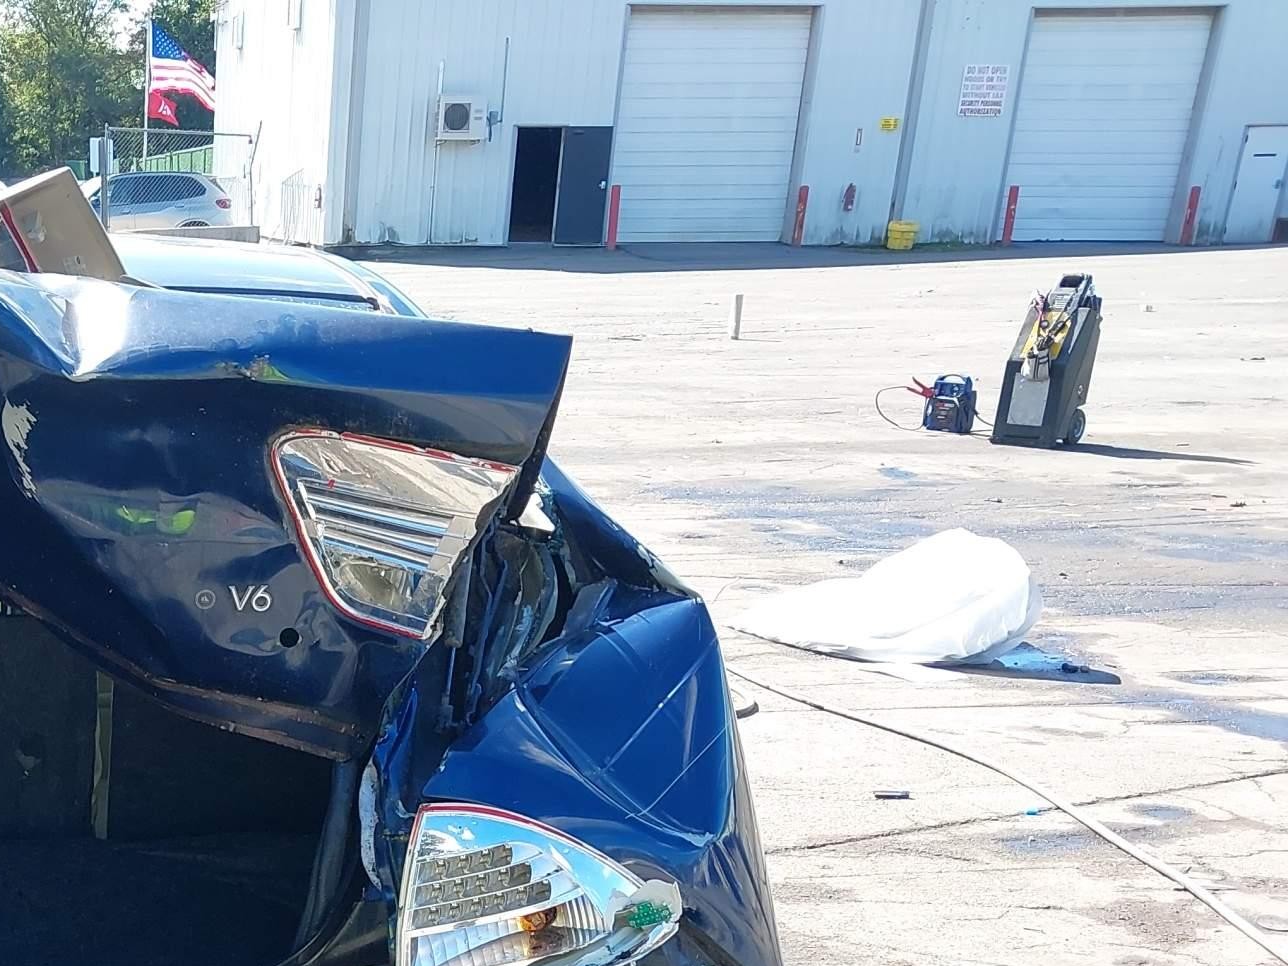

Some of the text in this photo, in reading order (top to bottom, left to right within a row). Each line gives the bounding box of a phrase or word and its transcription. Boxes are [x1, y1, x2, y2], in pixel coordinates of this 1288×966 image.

[967, 65, 1007, 75] DO NOT OPEN
[985, 75, 994, 83] OR
[963, 83, 970, 91] TO
[961, 91, 991, 99] WITHOUT
[960, 99, 980, 107] SECURITY
[959, 107, 1002, 116] AUTHORIZATION
[228, 584, 272, 612] V6
